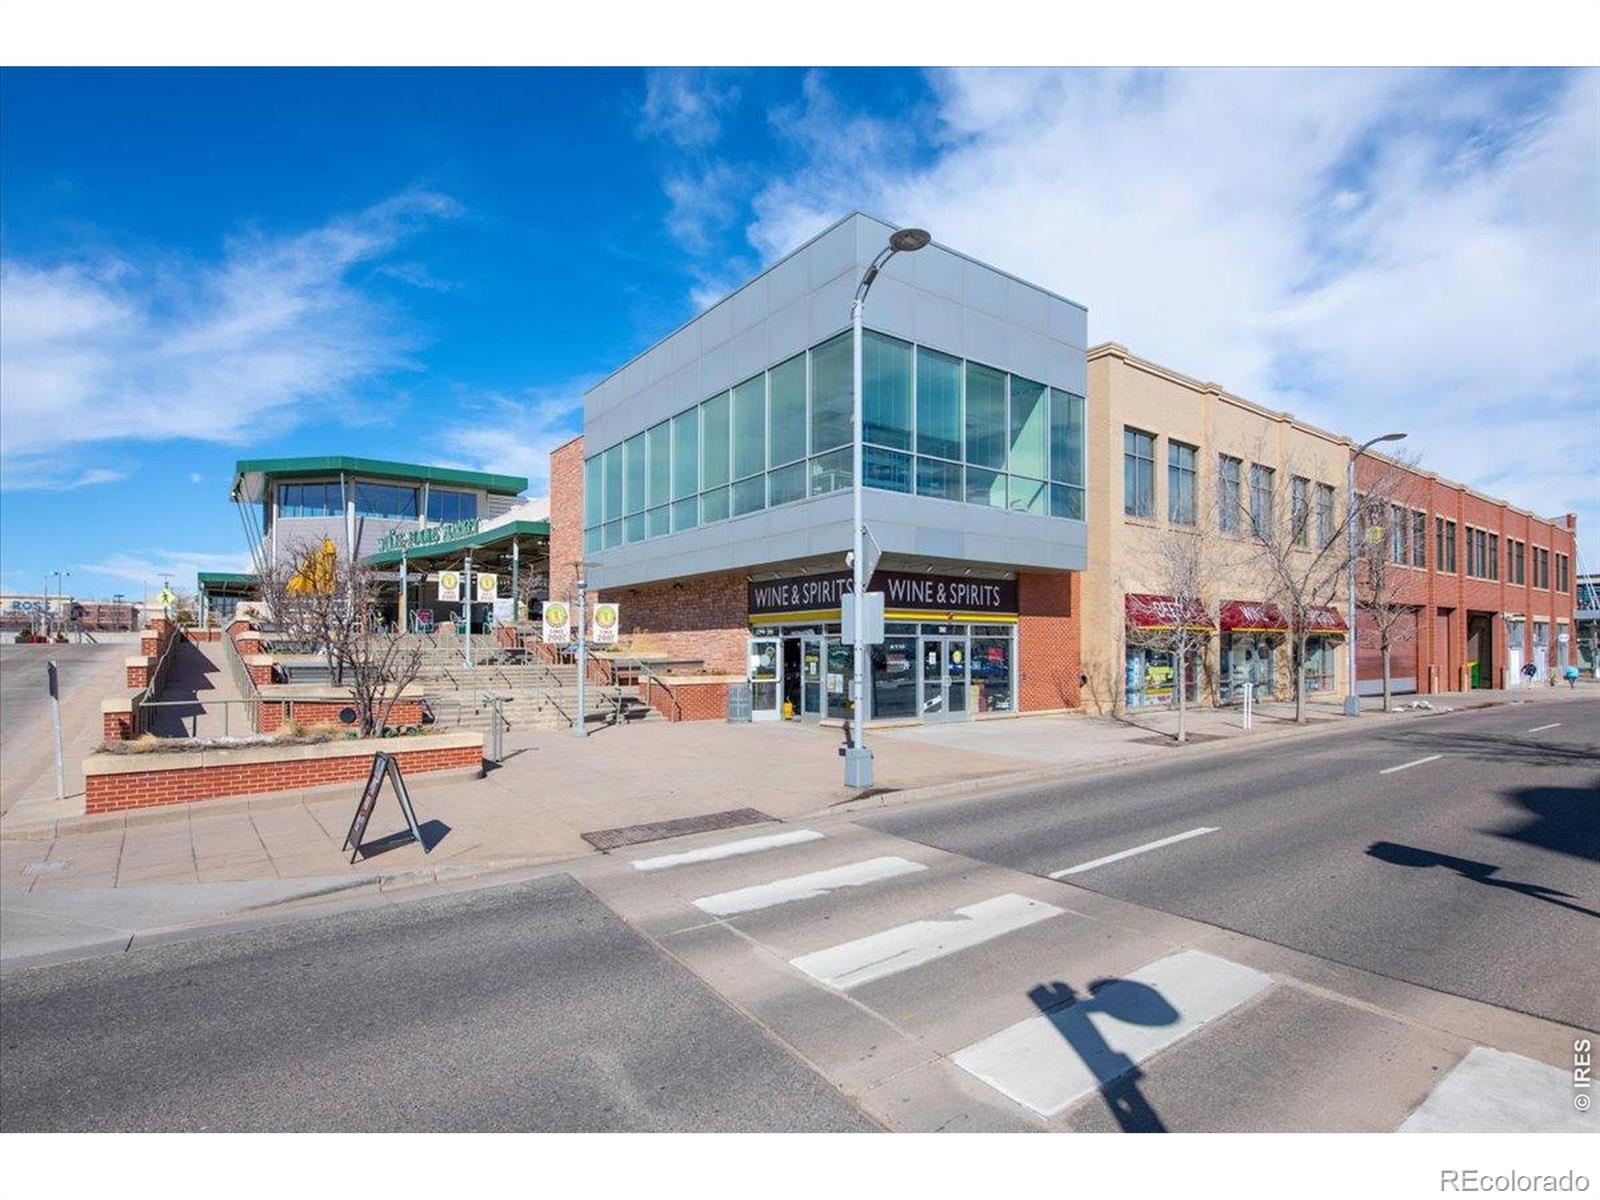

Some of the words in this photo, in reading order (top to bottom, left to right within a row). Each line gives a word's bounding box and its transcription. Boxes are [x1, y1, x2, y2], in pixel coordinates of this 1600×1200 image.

[13, 600, 51, 611] ROSS
[755, 587, 788, 608] WINE
[791, 585, 800, 603] &
[802, 578, 853, 603] SPIRITS
[888, 578, 933, 603] WINE
[937, 583, 947, 604] &
[950, 584, 1001, 606] SPIRITS
